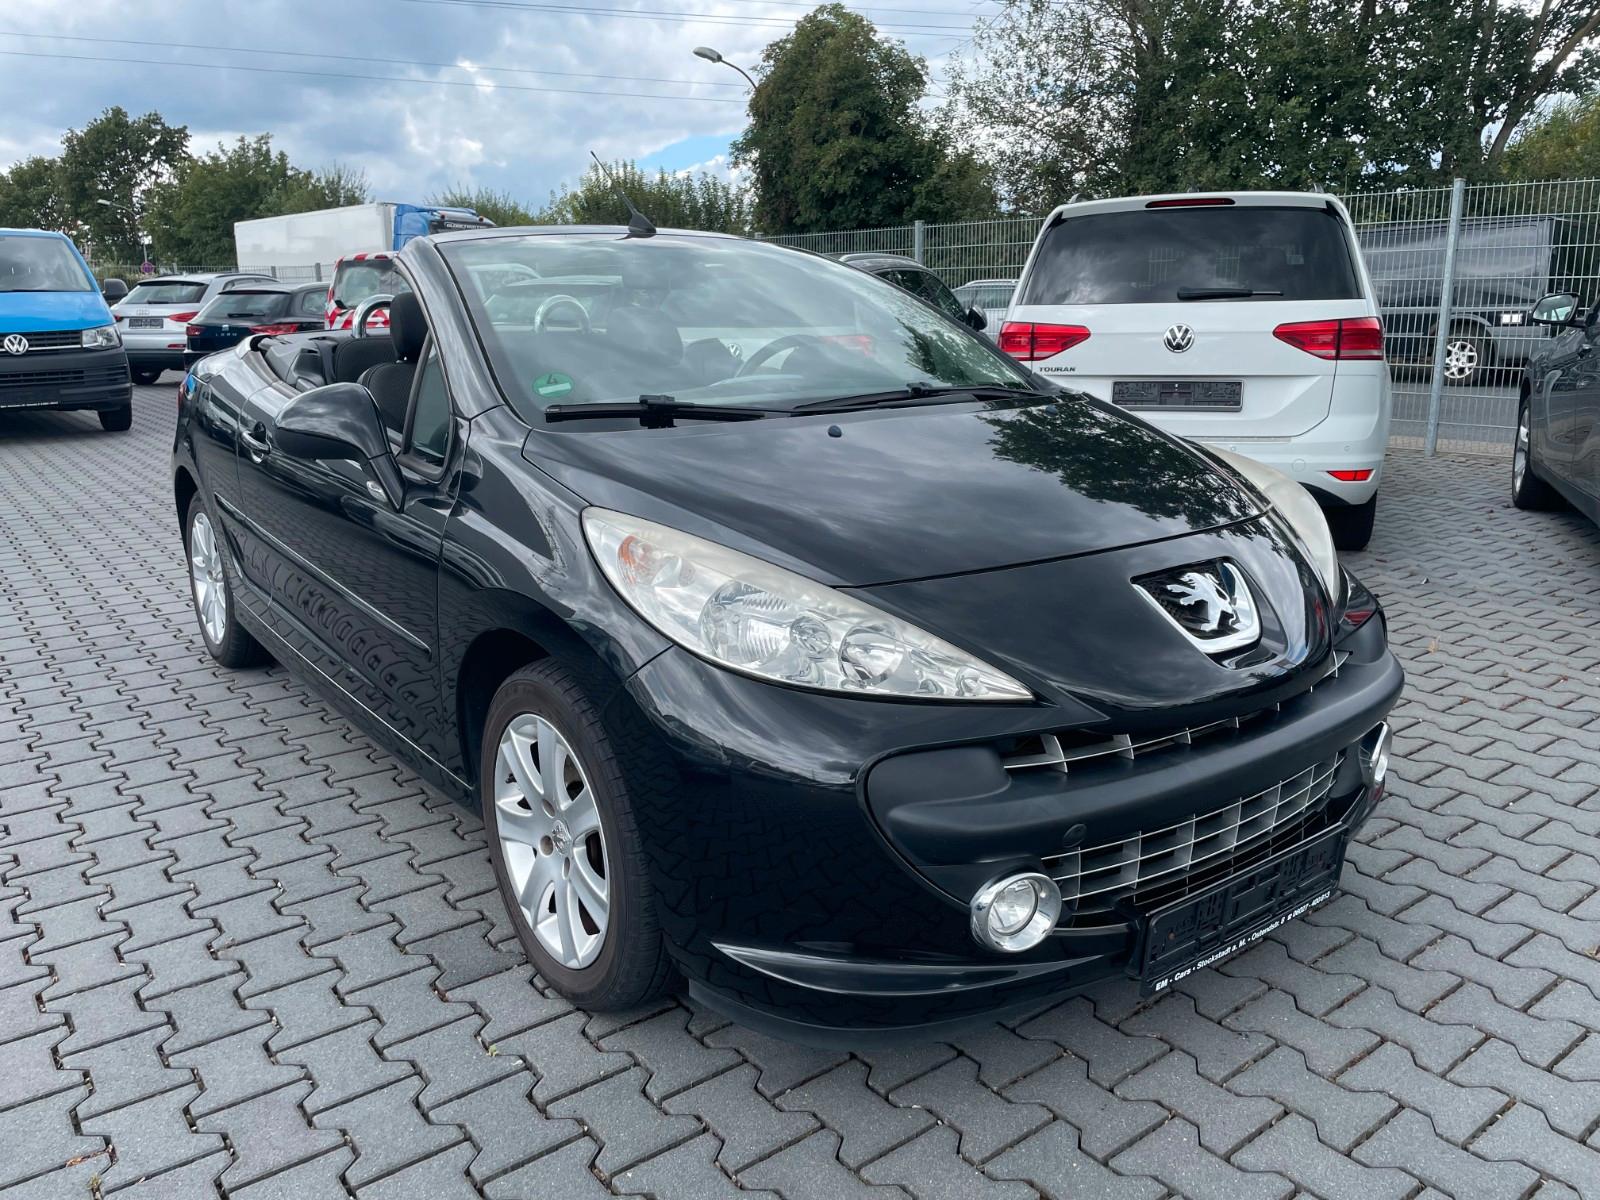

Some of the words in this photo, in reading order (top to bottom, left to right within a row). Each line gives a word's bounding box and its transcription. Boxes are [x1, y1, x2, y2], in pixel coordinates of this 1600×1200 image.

[1155, 978, 1169, 991] EM
[1174, 968, 1191, 981] Cars
[1197, 946, 1232, 970] Stockstadt
